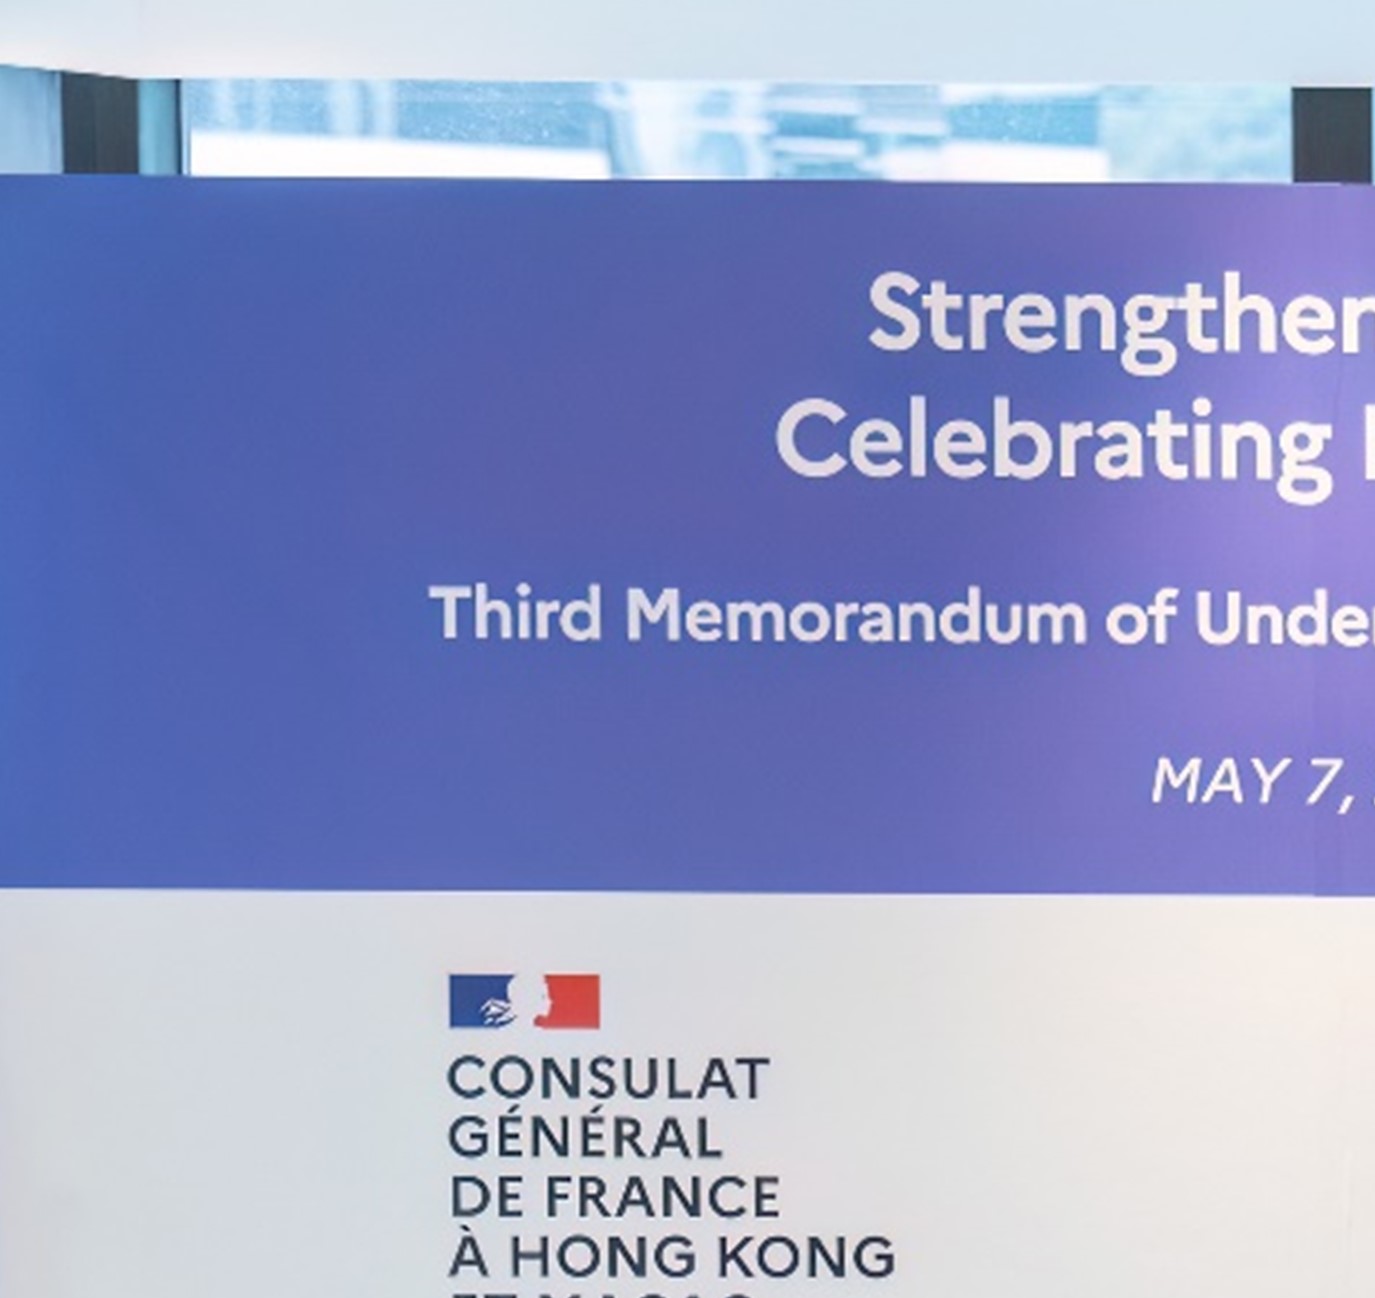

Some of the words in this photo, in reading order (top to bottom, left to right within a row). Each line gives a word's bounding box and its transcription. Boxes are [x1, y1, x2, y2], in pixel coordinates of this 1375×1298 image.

[776, 392, 1333, 505] Celebrating
[429, 583, 600, 641] Third
[628, 586, 1086, 644] Memorandum
[1107, 588, 1179, 644] of
[1153, 757, 1292, 803] MAY
[1307, 758, 1353, 814] 7,
[448, 1055, 771, 1100] CONSULAT
[449, 1104, 722, 1158] GÉNÉRAL
[453, 1176, 522, 1217] DE
[548, 1176, 779, 1218] FRANCE
[449, 1225, 488, 1276] À
[512, 1235, 695, 1277] HONG
[719, 1236, 894, 1278] KONG
